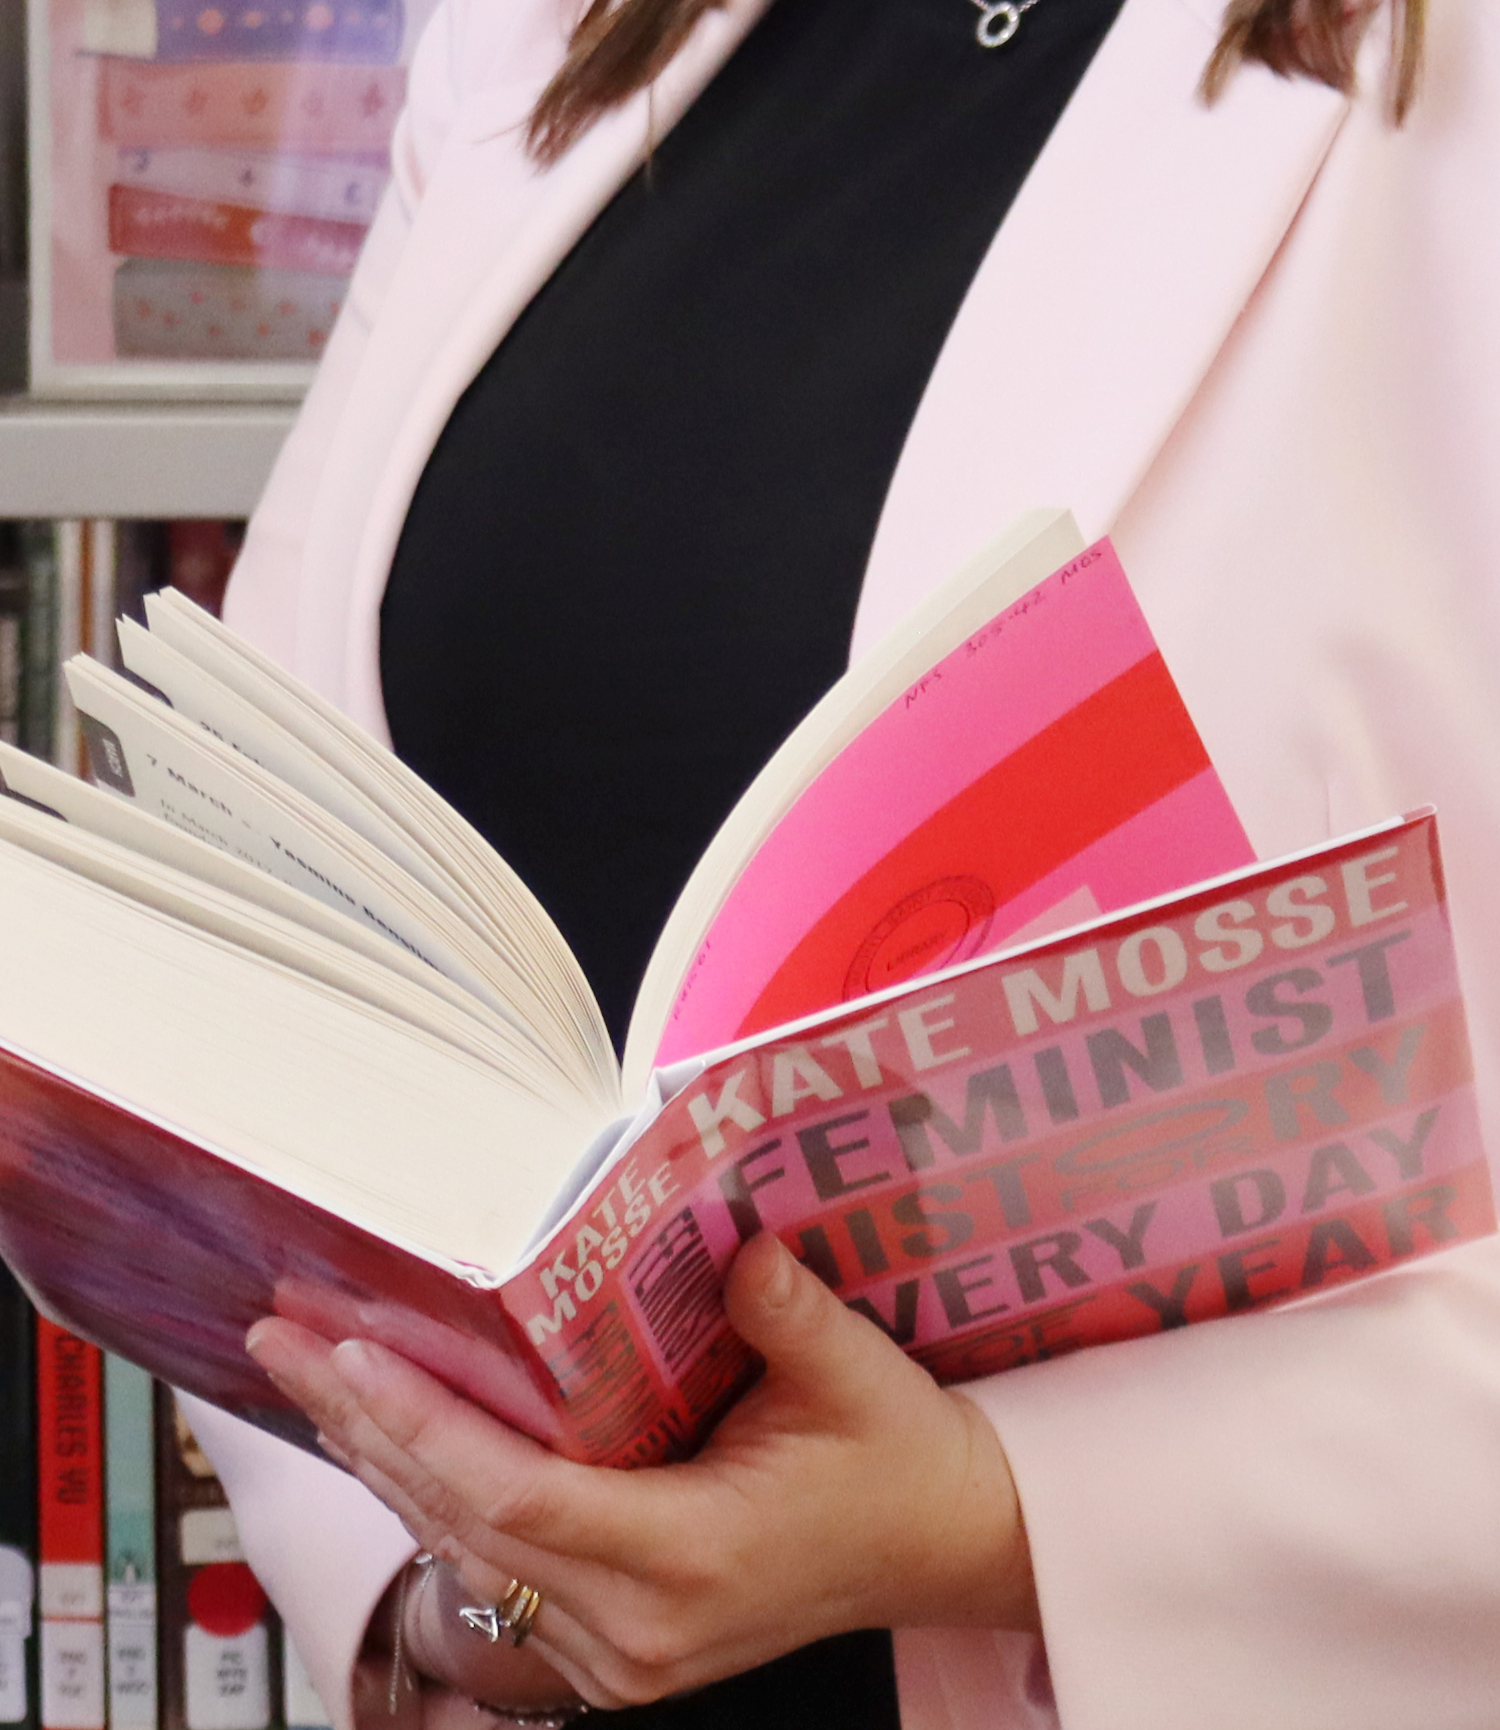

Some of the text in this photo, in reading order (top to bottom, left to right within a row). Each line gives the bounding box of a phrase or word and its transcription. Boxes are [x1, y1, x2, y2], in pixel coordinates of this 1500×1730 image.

[685, 992, 972, 1162] KATE
[1000, 846, 1409, 1038] MOSSE
[716, 929, 1412, 1243] FEMINIST
[526, 1159, 682, 1347] MOSSE
[538, 1157, 646, 1300] KATE
[840, 1200, 1160, 1350] VERY
[1208, 1106, 1444, 1241] DAY
[1123, 1181, 1464, 1336] YEAR
[53, 1336, 89, 1506] CHARLES YU
